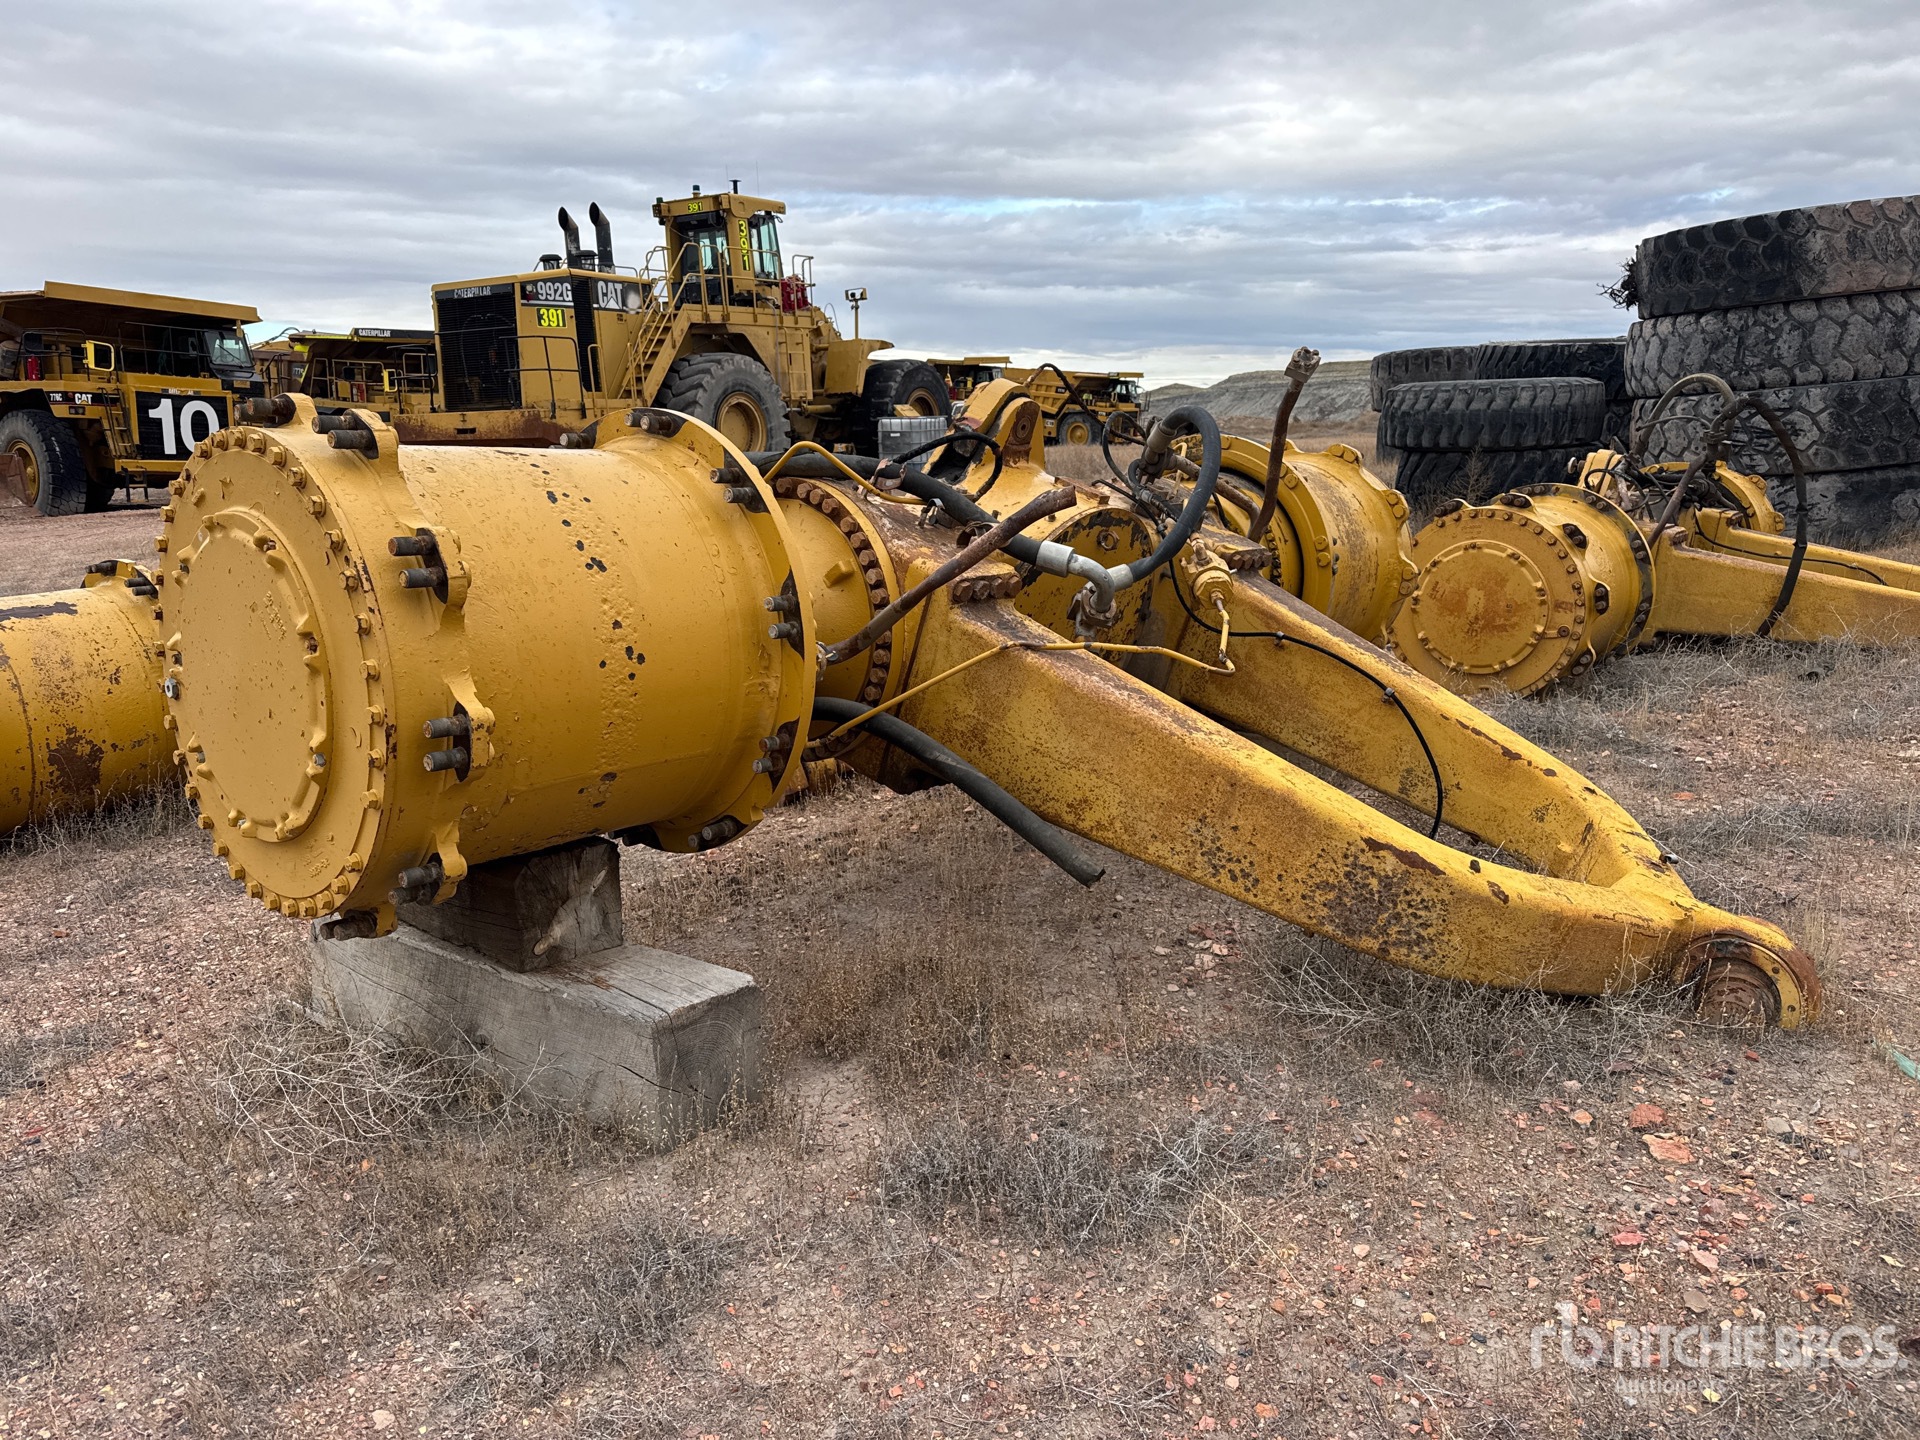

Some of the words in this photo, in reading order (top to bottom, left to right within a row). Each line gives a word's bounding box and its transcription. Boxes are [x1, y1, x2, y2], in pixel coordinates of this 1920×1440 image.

[688, 203, 703, 212] 391
[738, 220, 749, 270] 391
[537, 281, 572, 301] 992G
[597, 281, 622, 309] CAT
[540, 308, 563, 327] 391
[358, 329, 391, 337] CATERPILLAR
[49, 393, 62, 402] 776C
[74, 393, 92, 405] CAT
[148, 398, 220, 455] 10
